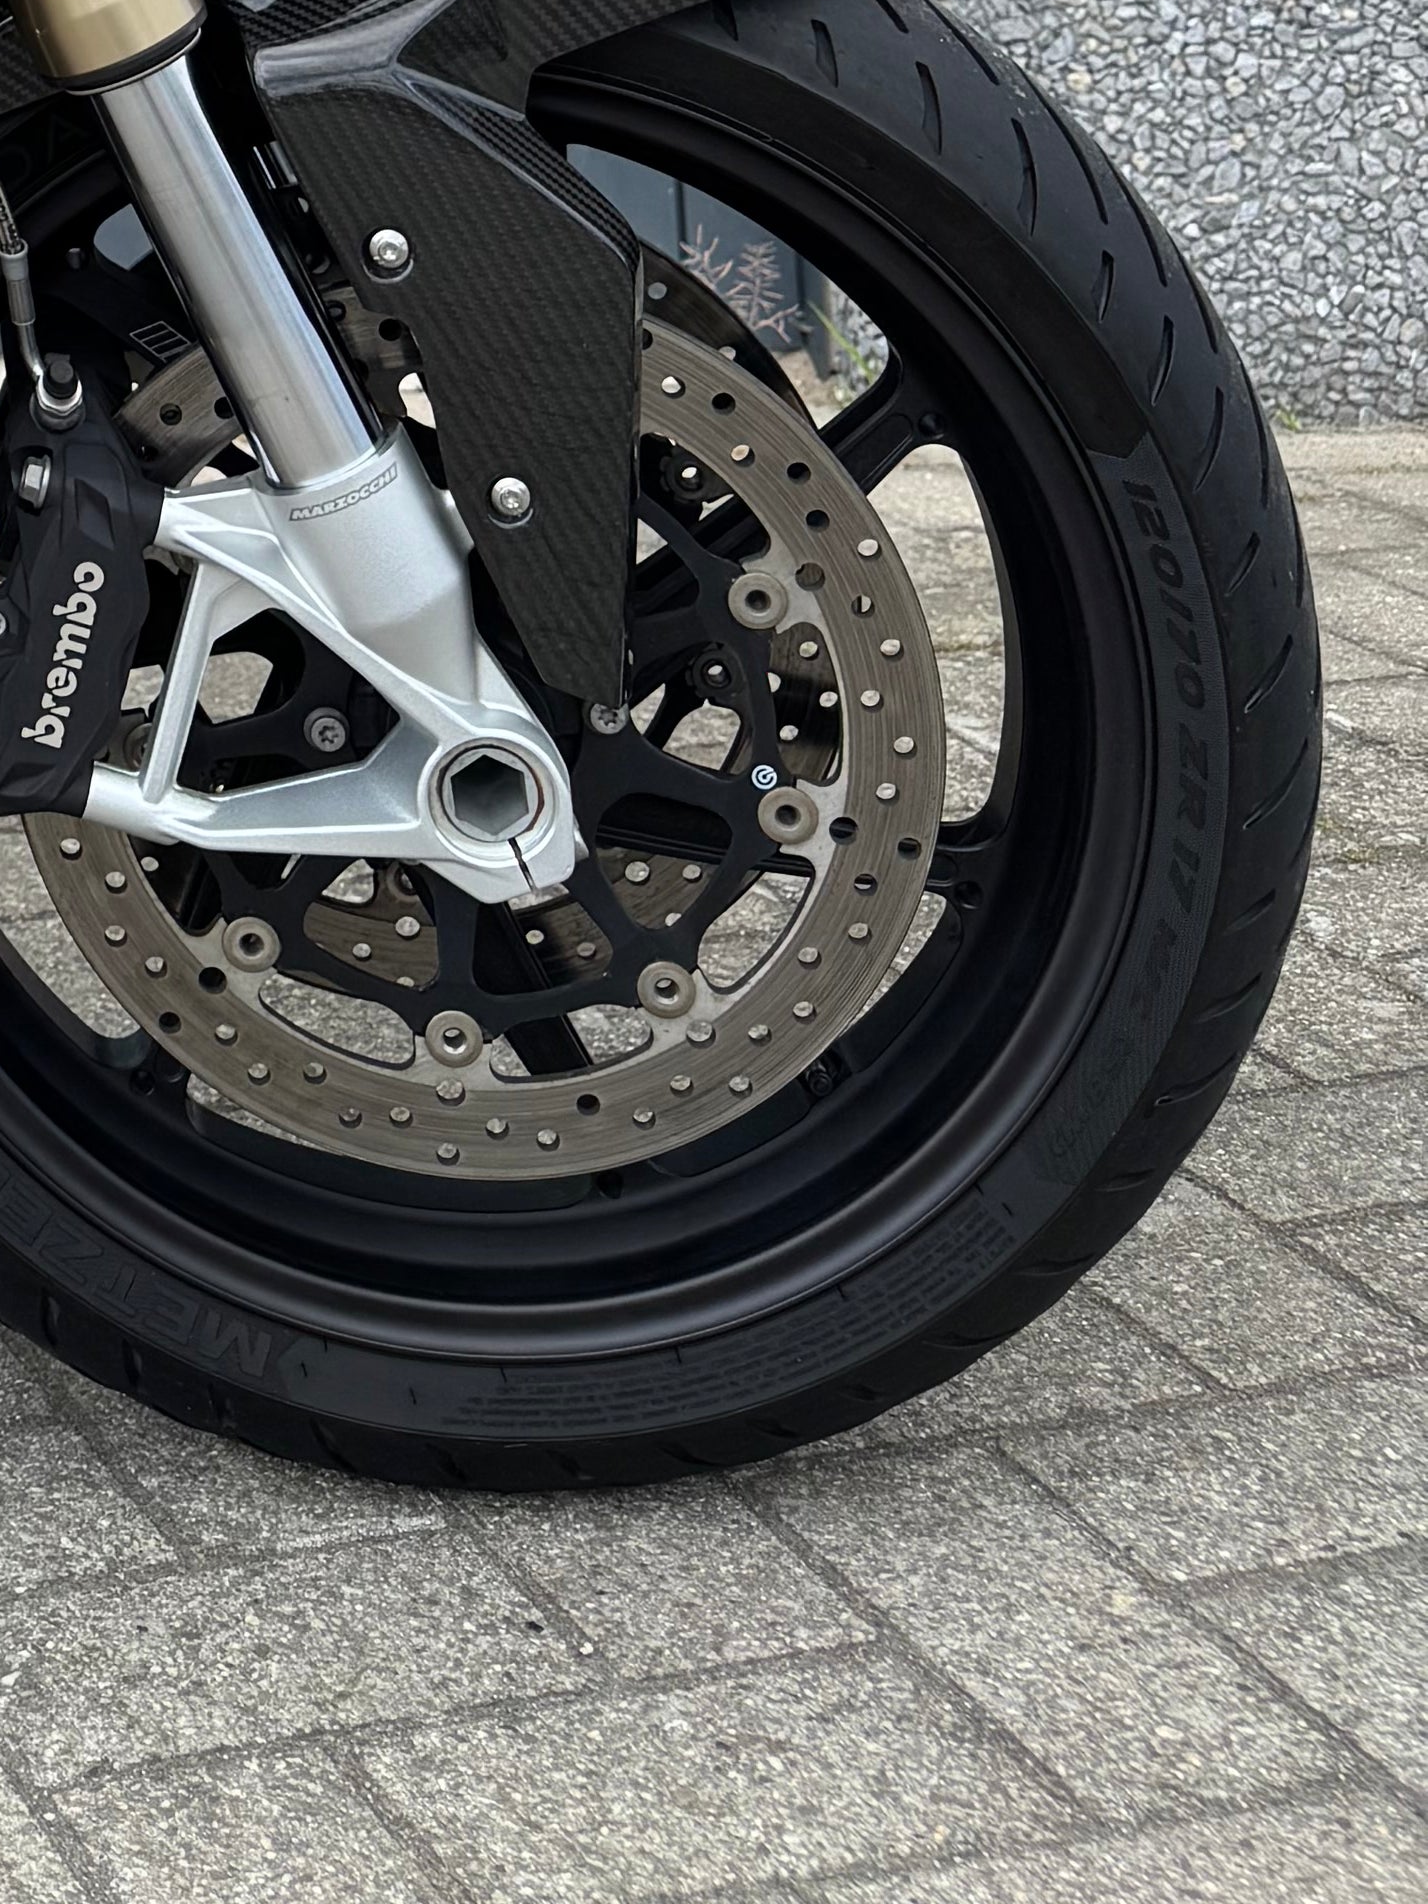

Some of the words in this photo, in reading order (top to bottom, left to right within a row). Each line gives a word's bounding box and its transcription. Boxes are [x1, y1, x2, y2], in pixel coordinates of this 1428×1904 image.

[292, 463, 397, 521] MARZOCCHI
[21, 560, 105, 749] brembo
[1122, 478, 1208, 710] 120/70
